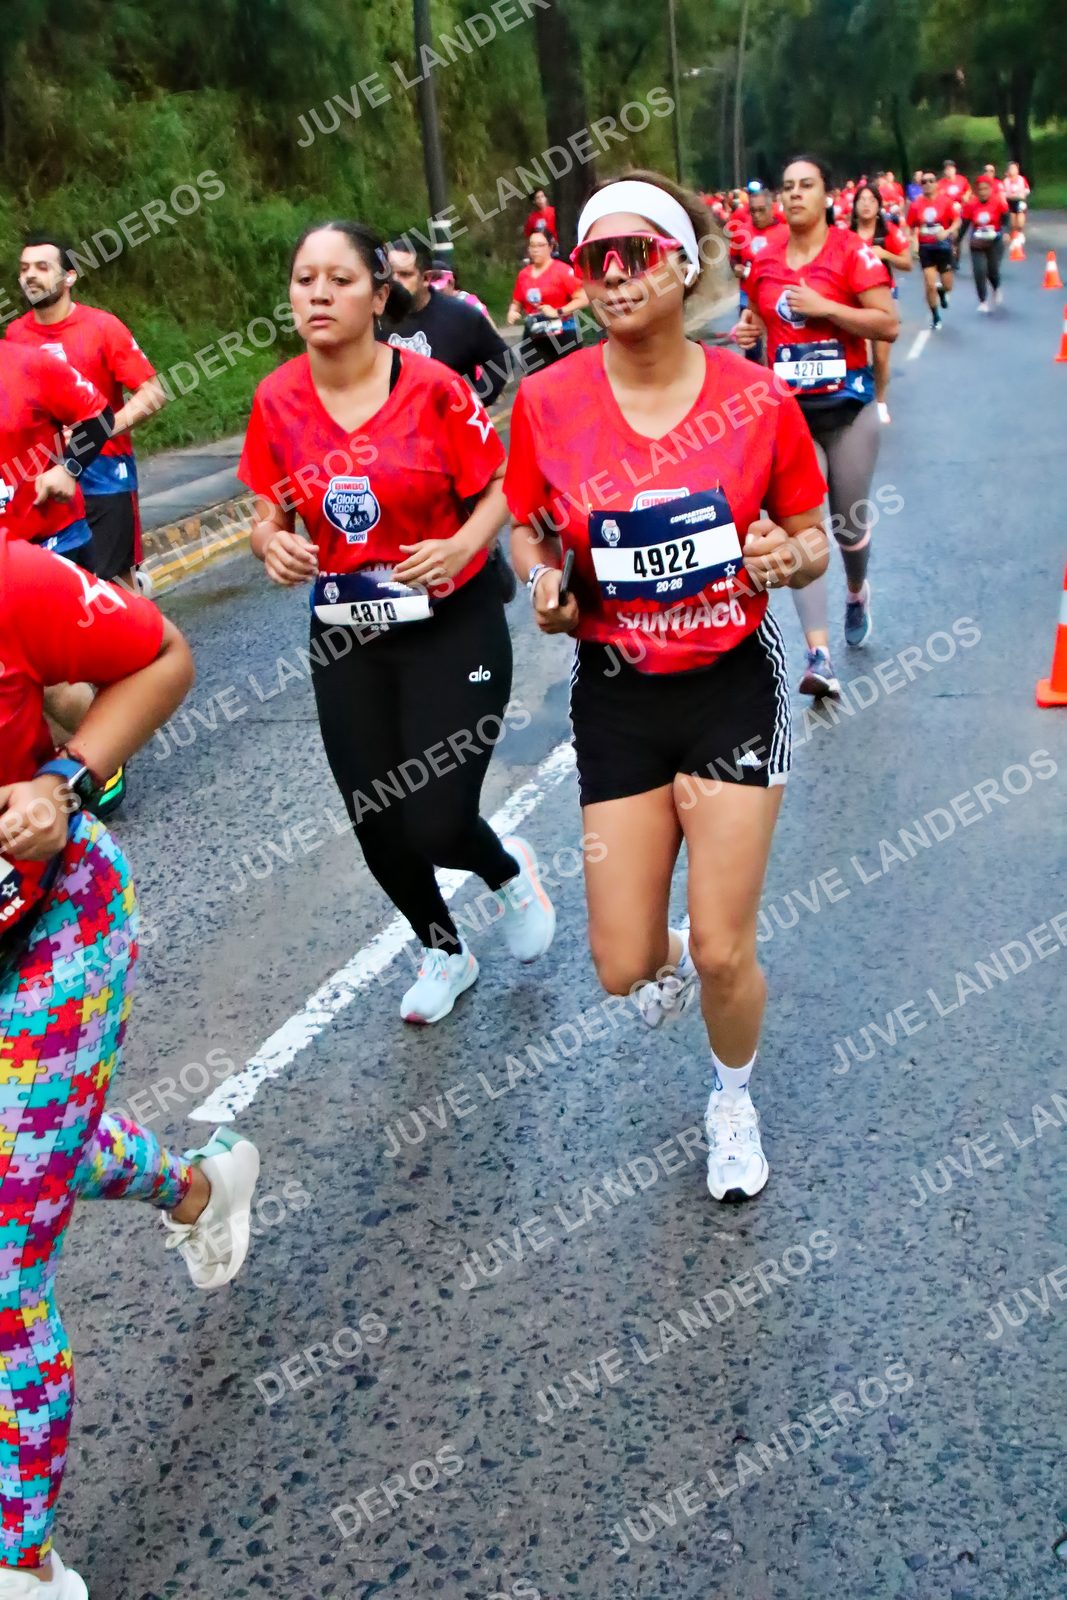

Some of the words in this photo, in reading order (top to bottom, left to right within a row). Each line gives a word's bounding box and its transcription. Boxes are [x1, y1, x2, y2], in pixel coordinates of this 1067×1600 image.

[794, 362, 823, 377] 4270
[334, 482, 365, 491] BIMBO
[336, 493, 366, 505] Global
[641, 496, 682, 507] BIM
[332, 502, 356, 514] Race
[633, 538, 699, 578] 4922
[655, 577, 683, 593] 20-26
[711, 578, 735, 593] 10K
[350, 601, 398, 623] 4870
[616, 599, 746, 633] SANTIAGO
[468, 665, 491, 682] alo
